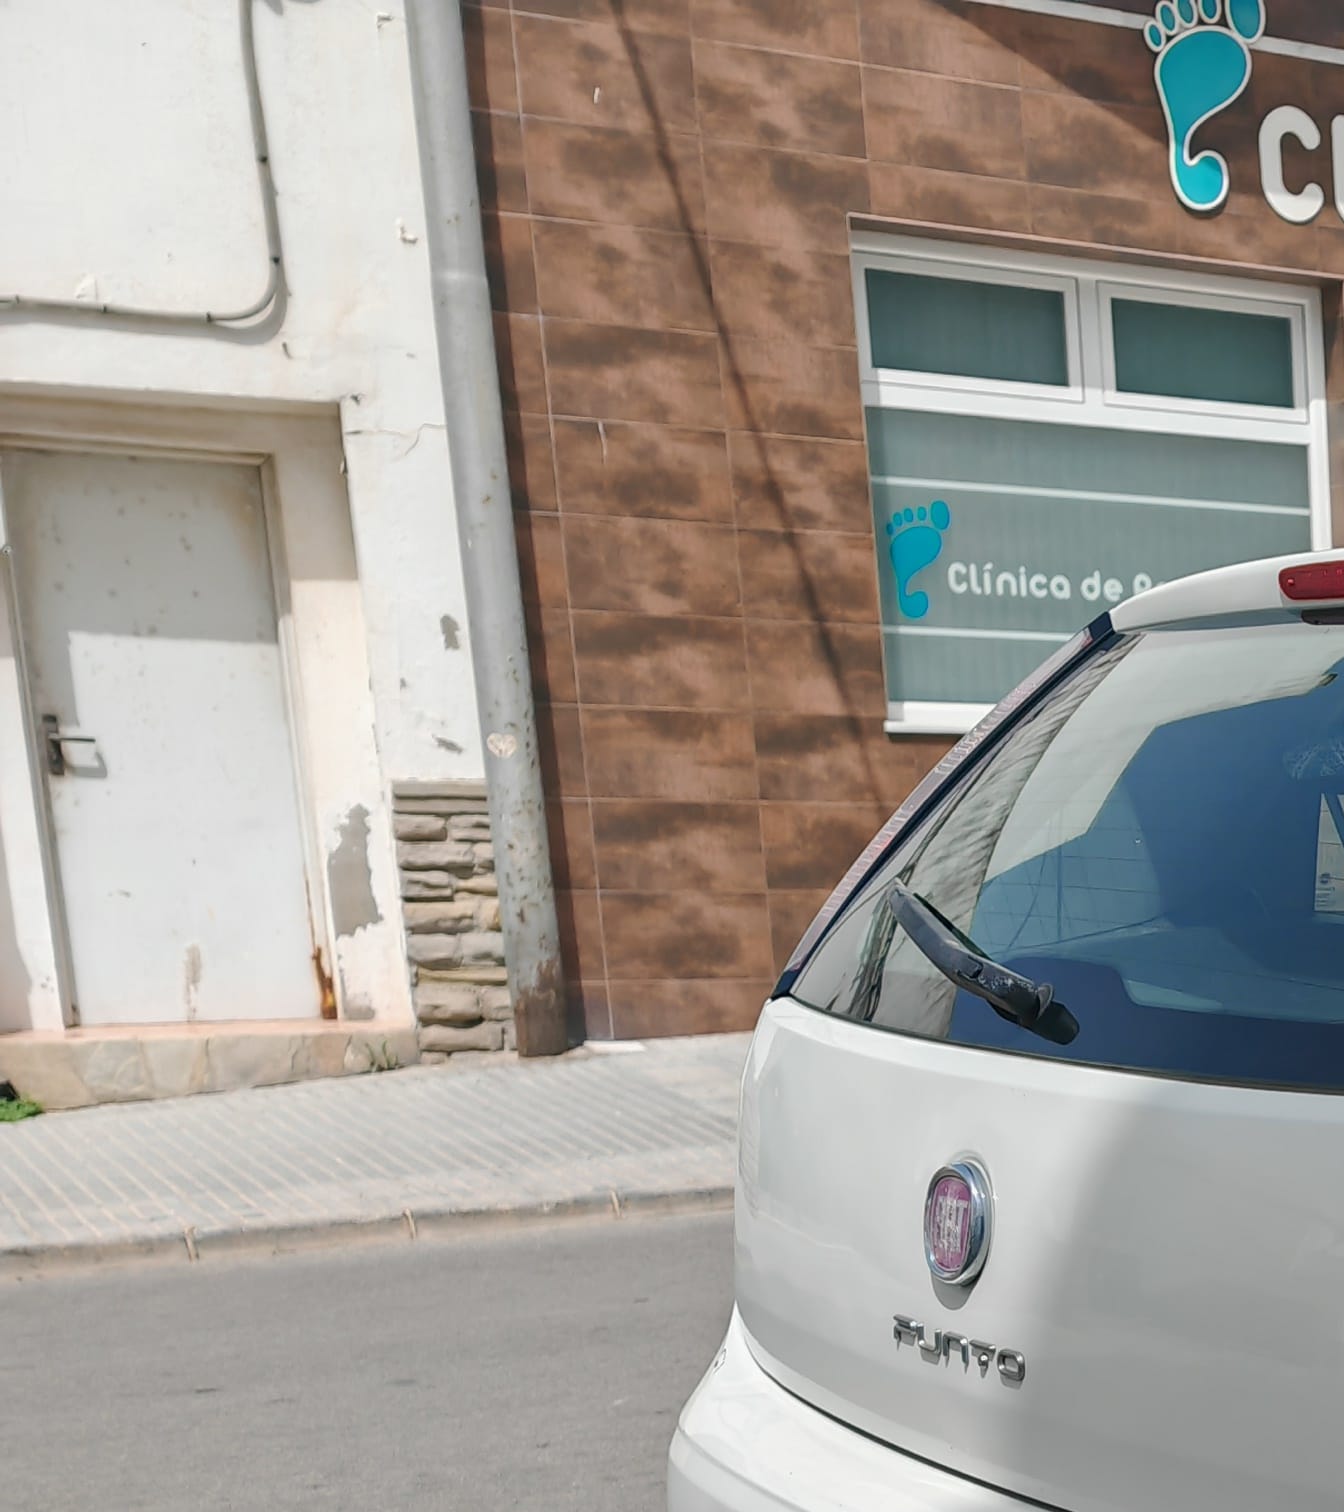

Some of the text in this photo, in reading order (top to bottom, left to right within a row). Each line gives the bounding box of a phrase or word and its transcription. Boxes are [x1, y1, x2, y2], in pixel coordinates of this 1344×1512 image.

[947, 561, 1167, 601] Clínica de P
[892, 1313, 1026, 1382] PUNTO
